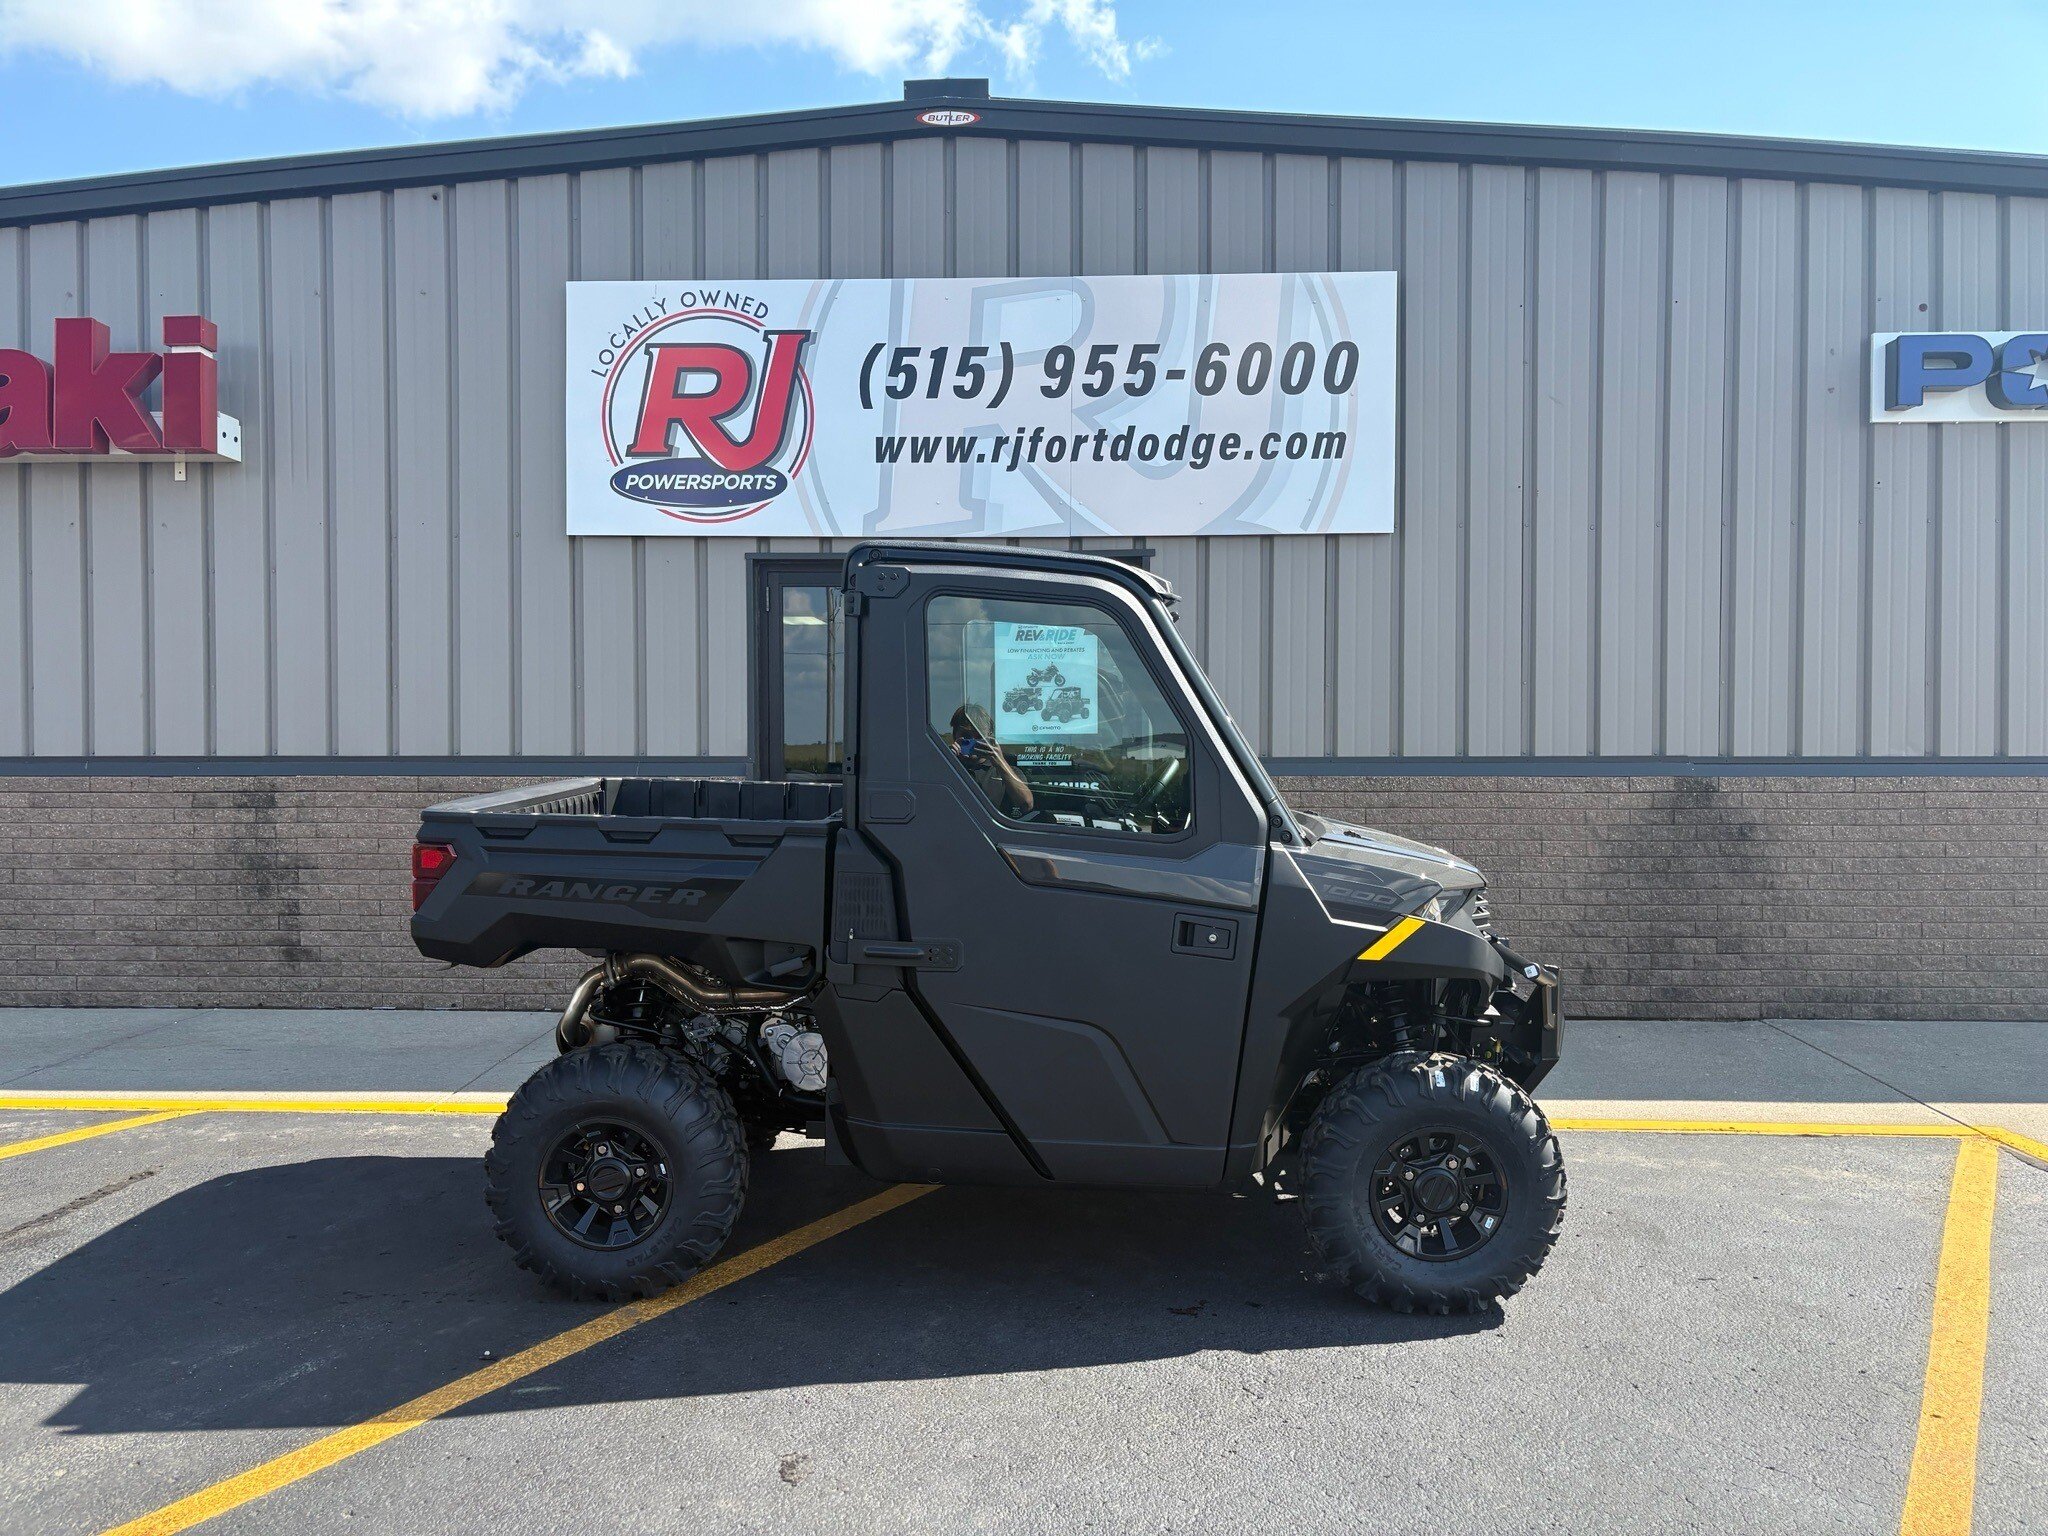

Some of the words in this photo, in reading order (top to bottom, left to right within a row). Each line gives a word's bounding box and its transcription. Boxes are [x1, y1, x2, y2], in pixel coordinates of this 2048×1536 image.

[927, 114, 971, 122] BUTLER
[591, 297, 669, 378] LOCALLY
[680, 289, 770, 319] OWNED
[858, 341, 1015, 409] (515)
[1040, 340, 1361, 399] 955-6000
[625, 329, 816, 471] RJ
[874, 424, 1347, 472] www.rjfortdodge.com
[624, 472, 778, 492] POWERSPORTS
[497, 877, 707, 906] RANGER
